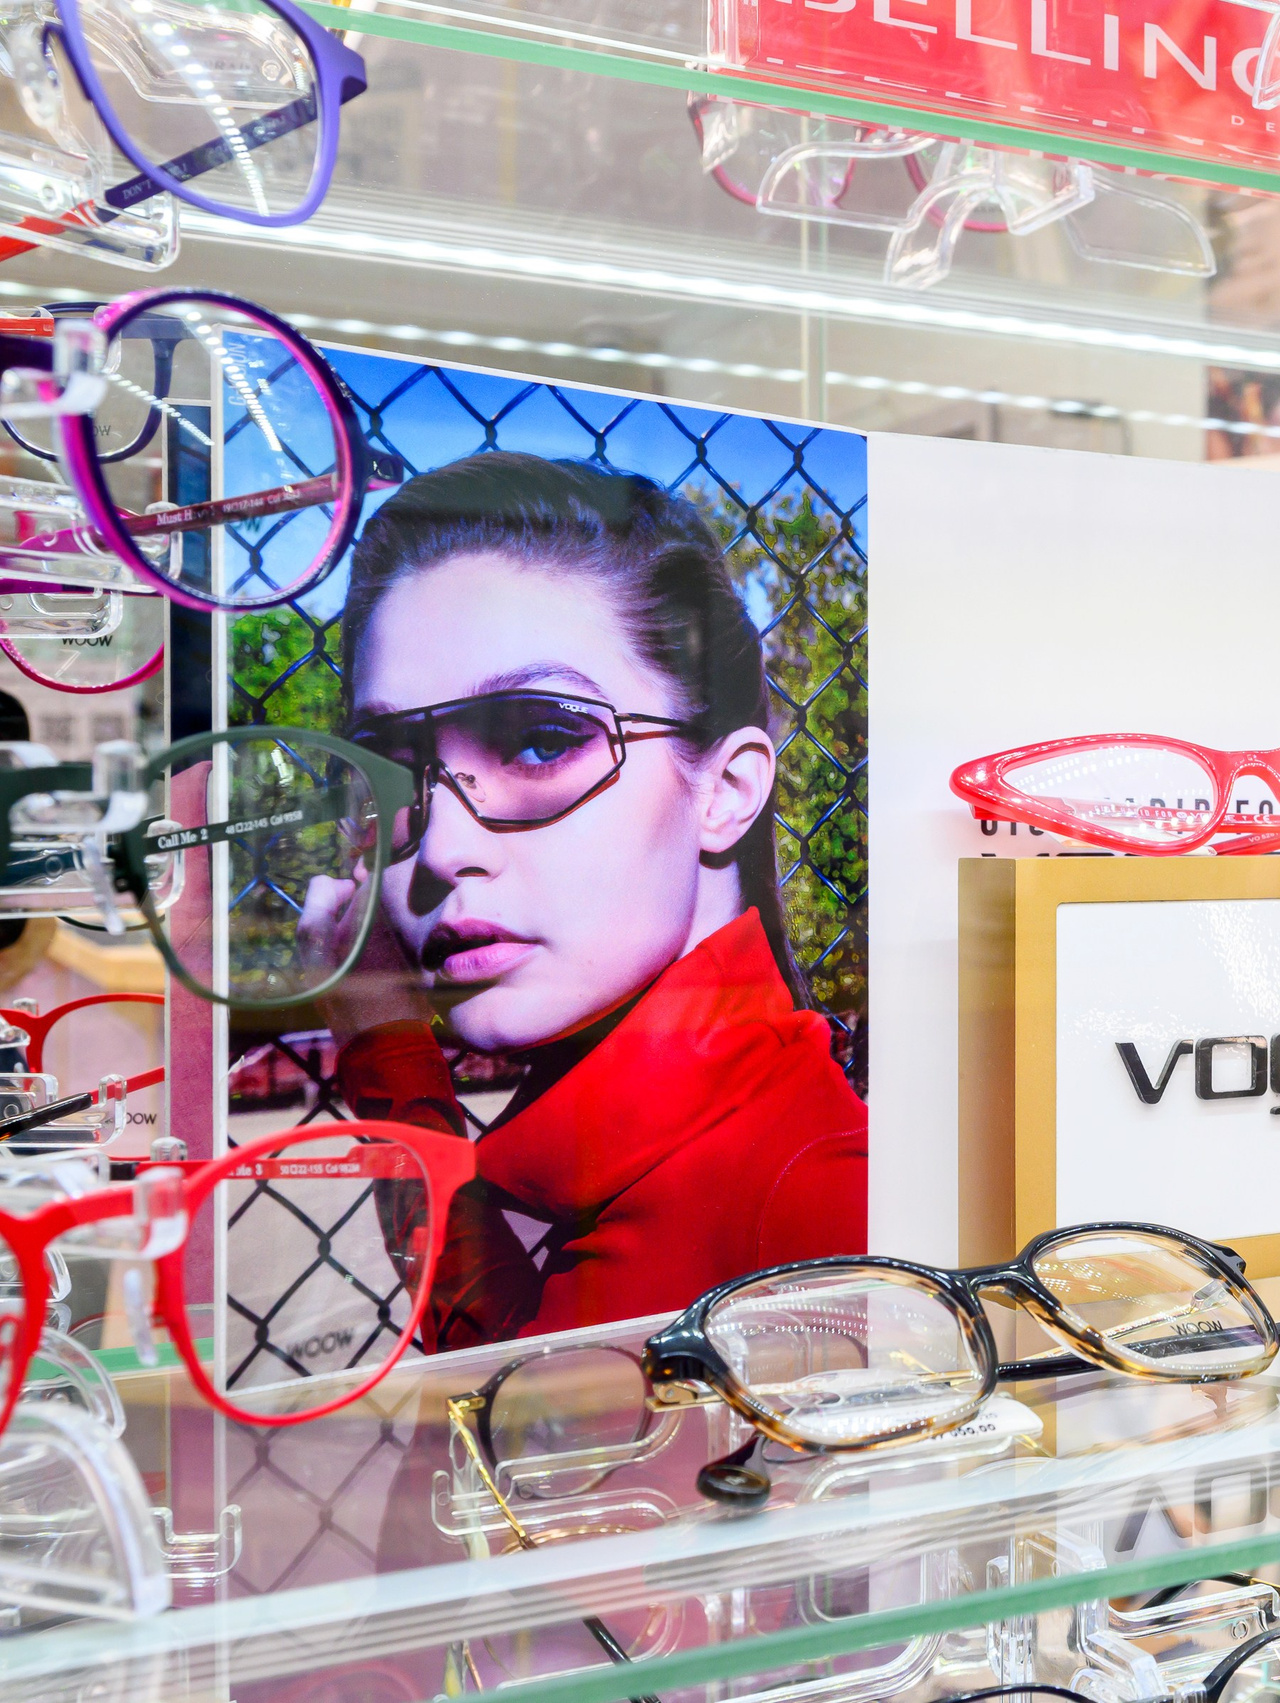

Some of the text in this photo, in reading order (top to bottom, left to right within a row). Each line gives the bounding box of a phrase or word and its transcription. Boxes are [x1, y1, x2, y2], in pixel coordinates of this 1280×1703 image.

[156, 511, 182, 526] Must
[157, 835, 179, 849] Call
[181, 830, 198, 844] Me
[200, 828, 209, 841] 2
[1170, 1320, 1224, 1336] WOOW
